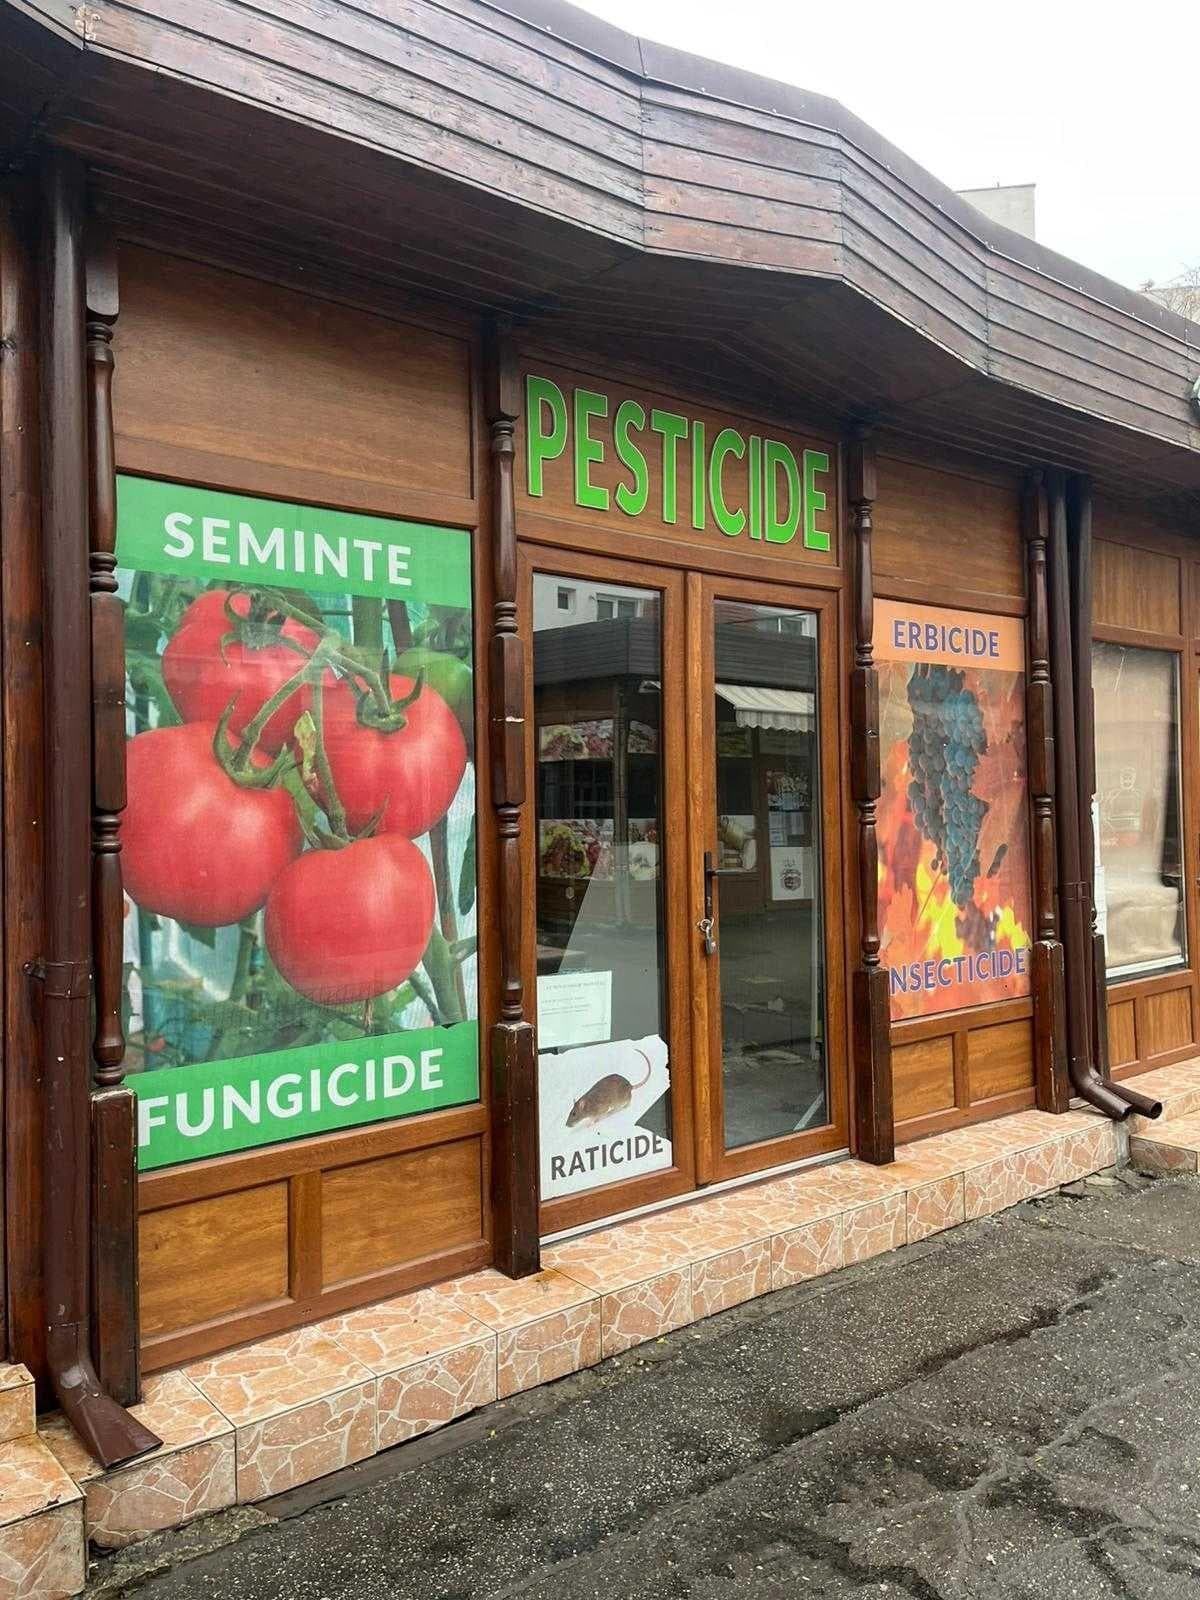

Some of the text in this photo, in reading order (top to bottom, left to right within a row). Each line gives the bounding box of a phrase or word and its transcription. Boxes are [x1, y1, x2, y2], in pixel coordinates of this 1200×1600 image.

[525, 374, 831, 551] PESTICIDE
[163, 511, 412, 586] SEMINTE
[894, 619, 999, 657] ERBICIDE
[889, 948, 1027, 994] NSECTICIDE
[137, 1048, 443, 1146] FUNGICIDE
[551, 1133, 664, 1180] RATICIDE
